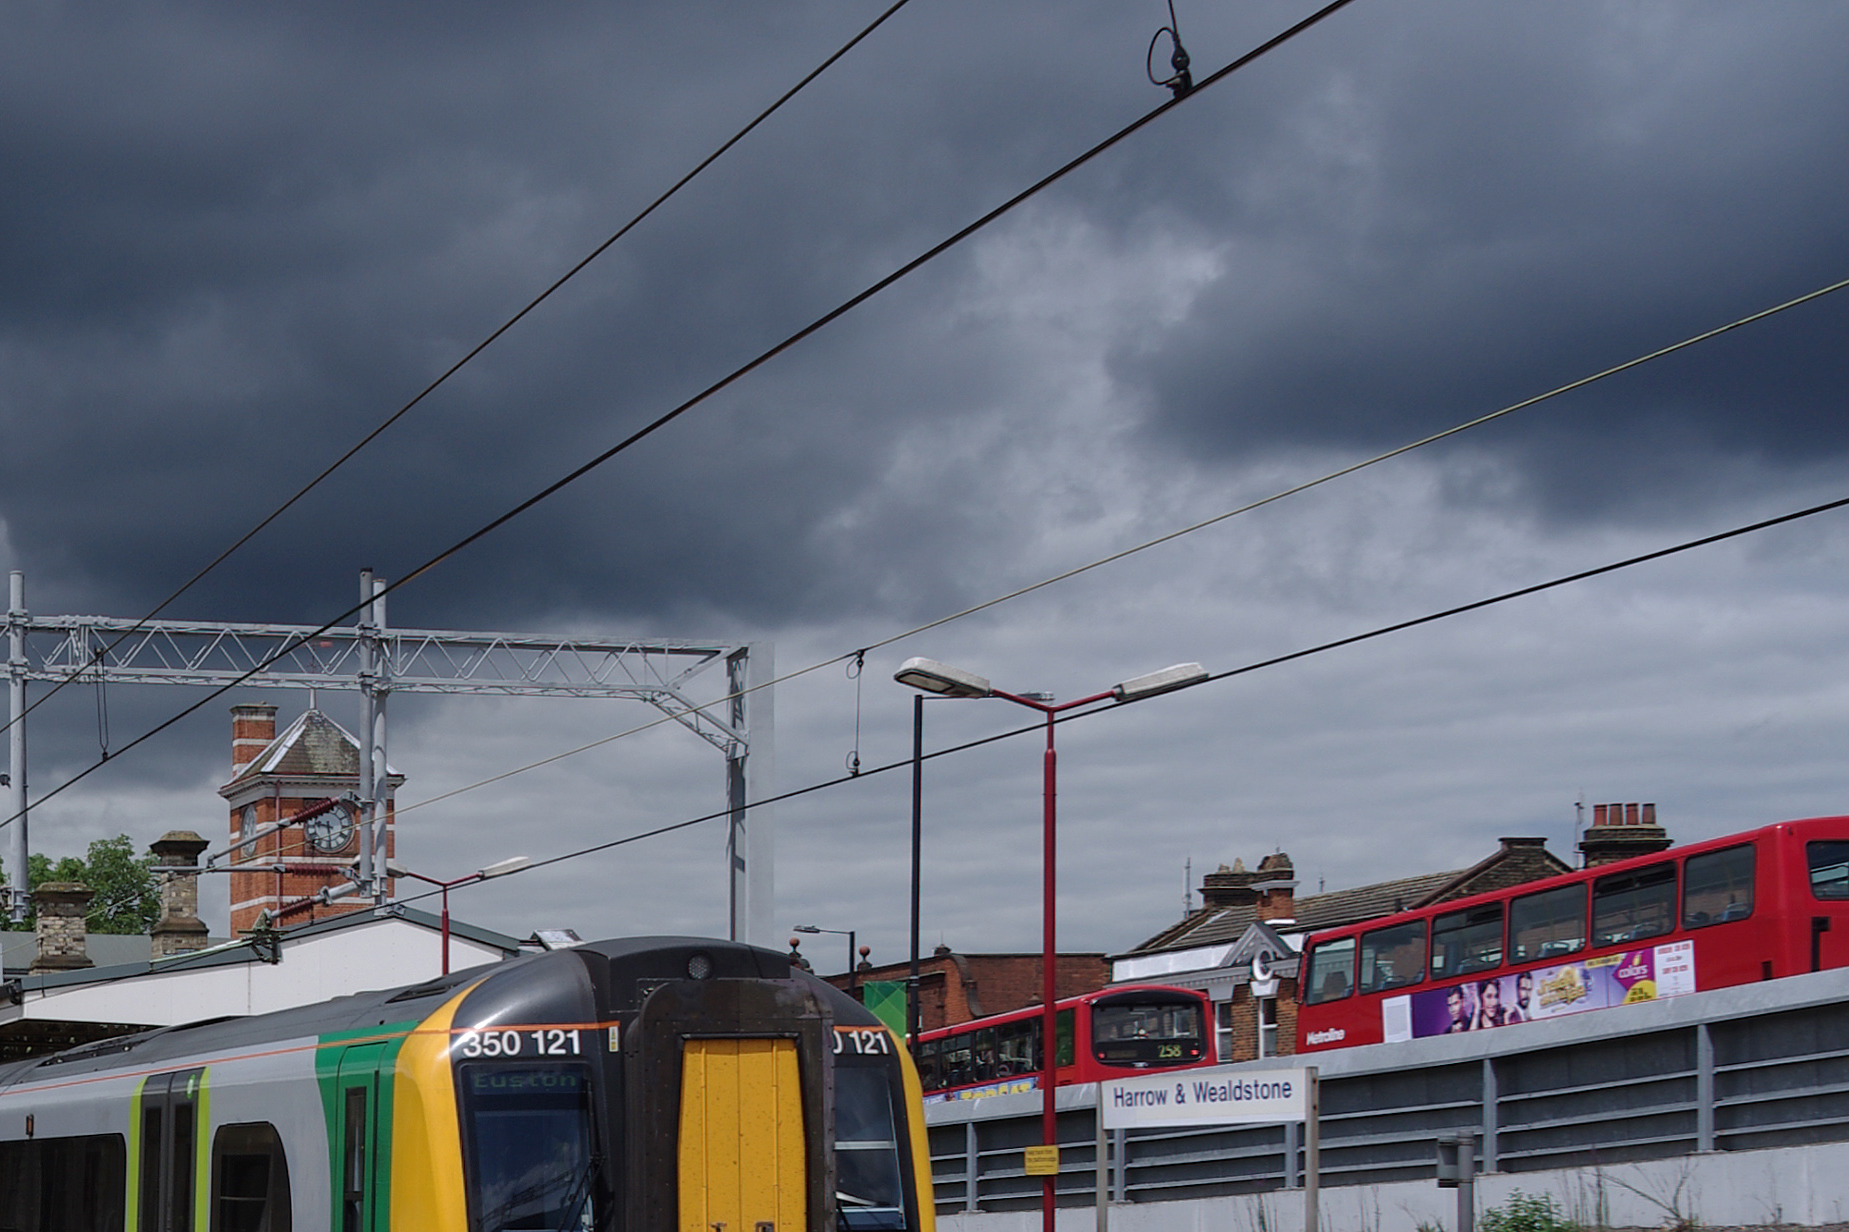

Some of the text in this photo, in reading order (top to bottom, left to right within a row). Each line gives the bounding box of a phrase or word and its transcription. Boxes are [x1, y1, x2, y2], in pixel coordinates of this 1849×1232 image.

[1618, 964, 1648, 978] colors
[463, 1029, 581, 1057] 350 121
[848, 1030, 889, 1054] 121
[1158, 1044, 1182, 1058] 258
[473, 1072, 577, 1089] Euston
[1113, 1079, 1293, 1107] Harrow & Wealdstone
